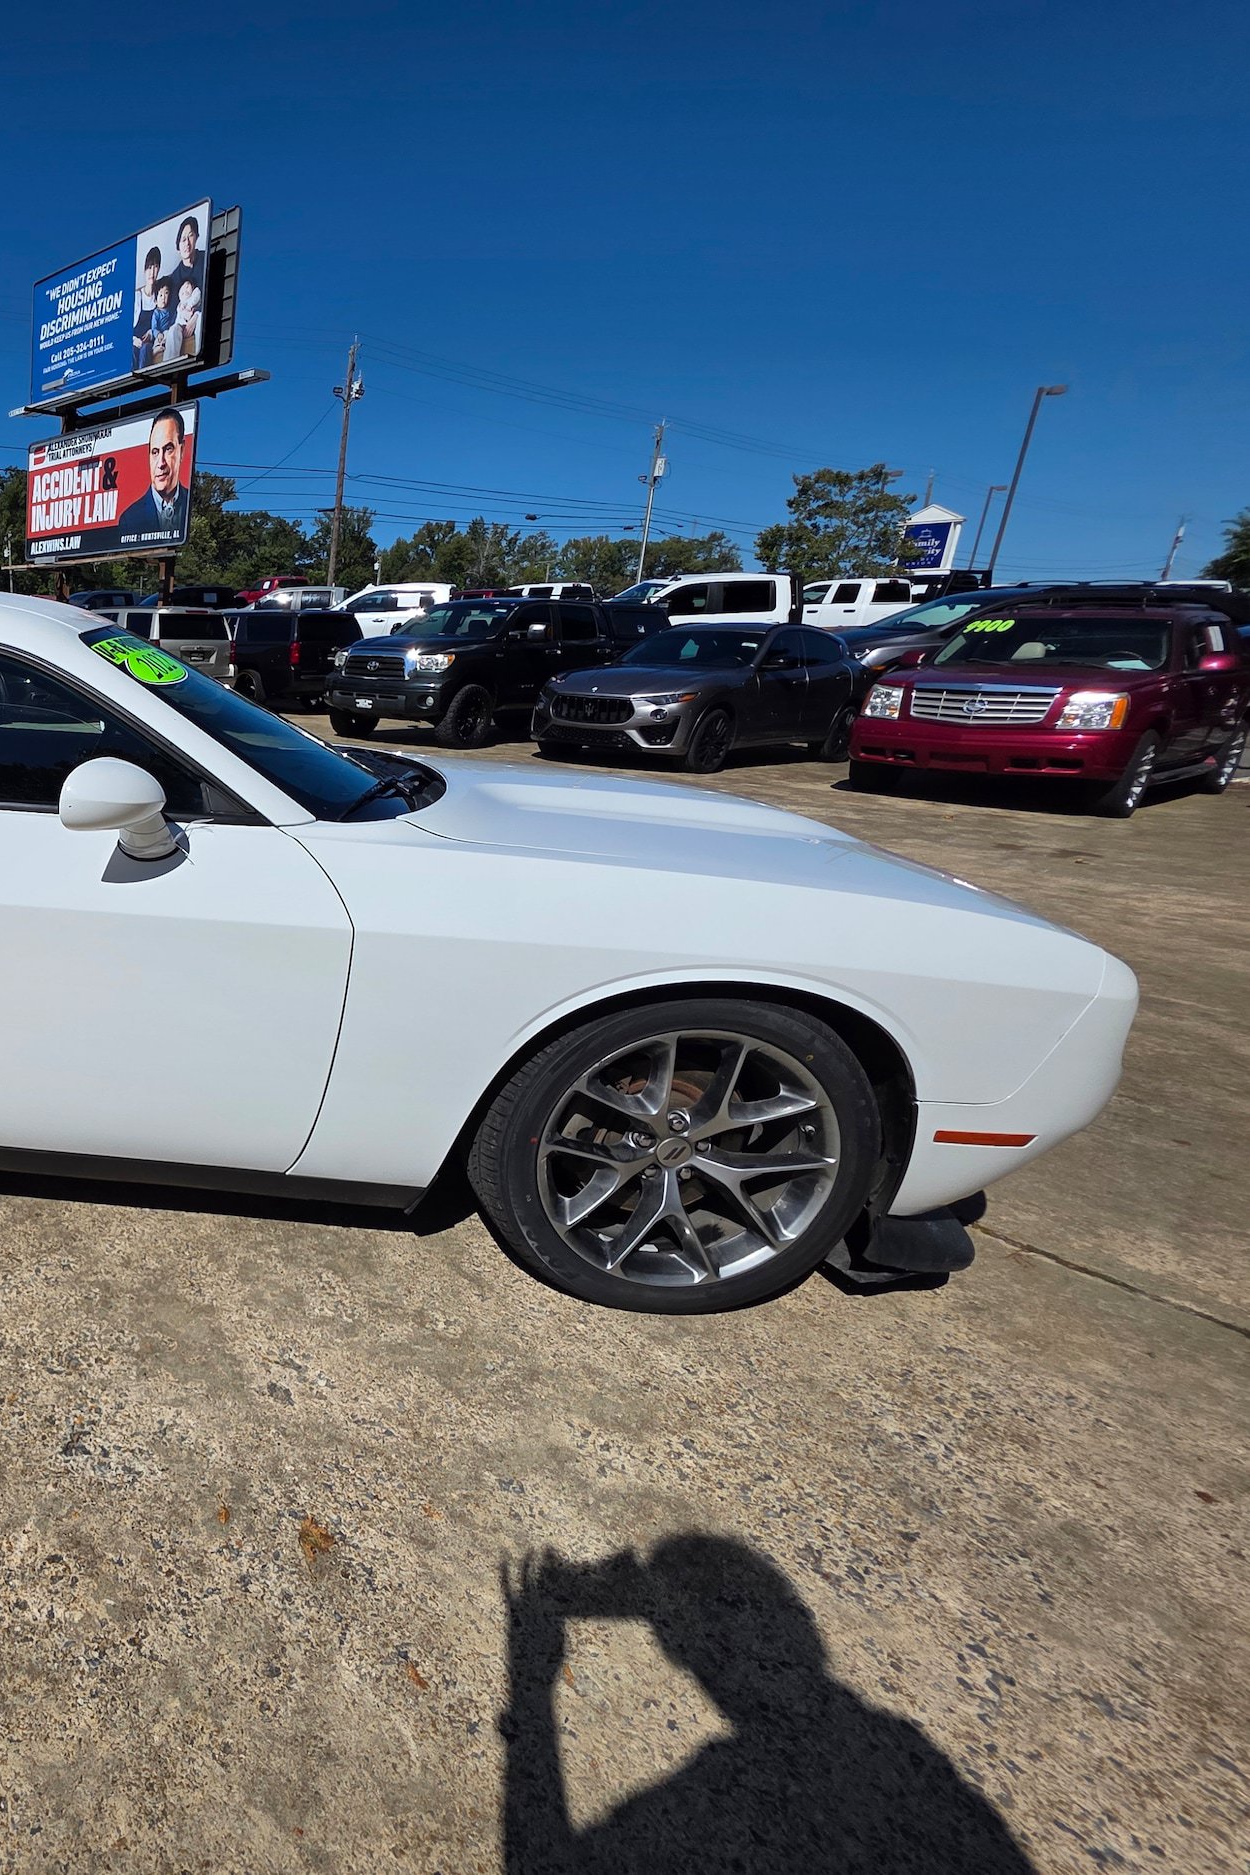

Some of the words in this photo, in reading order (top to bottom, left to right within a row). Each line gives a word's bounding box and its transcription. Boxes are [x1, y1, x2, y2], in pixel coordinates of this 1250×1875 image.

[62, 273, 86, 295] DIDN'T
[86, 258, 117, 284] EXPECT
[40, 290, 123, 341] DISCRIMINATION
[57, 281, 103, 316] HOUSING
[51, 351, 63, 363] Call
[49, 450, 62, 461] TRIAL
[62, 442, 93, 458] ATTORNEYS
[32, 461, 102, 504] ACCIDENT
[102, 457, 119, 491] &
[31, 496, 82, 533] INJURY
[84, 490, 119, 524] LAW
[30, 535, 82, 555] ALEXWINS.LAW
[963, 620, 1016, 634] 9900
